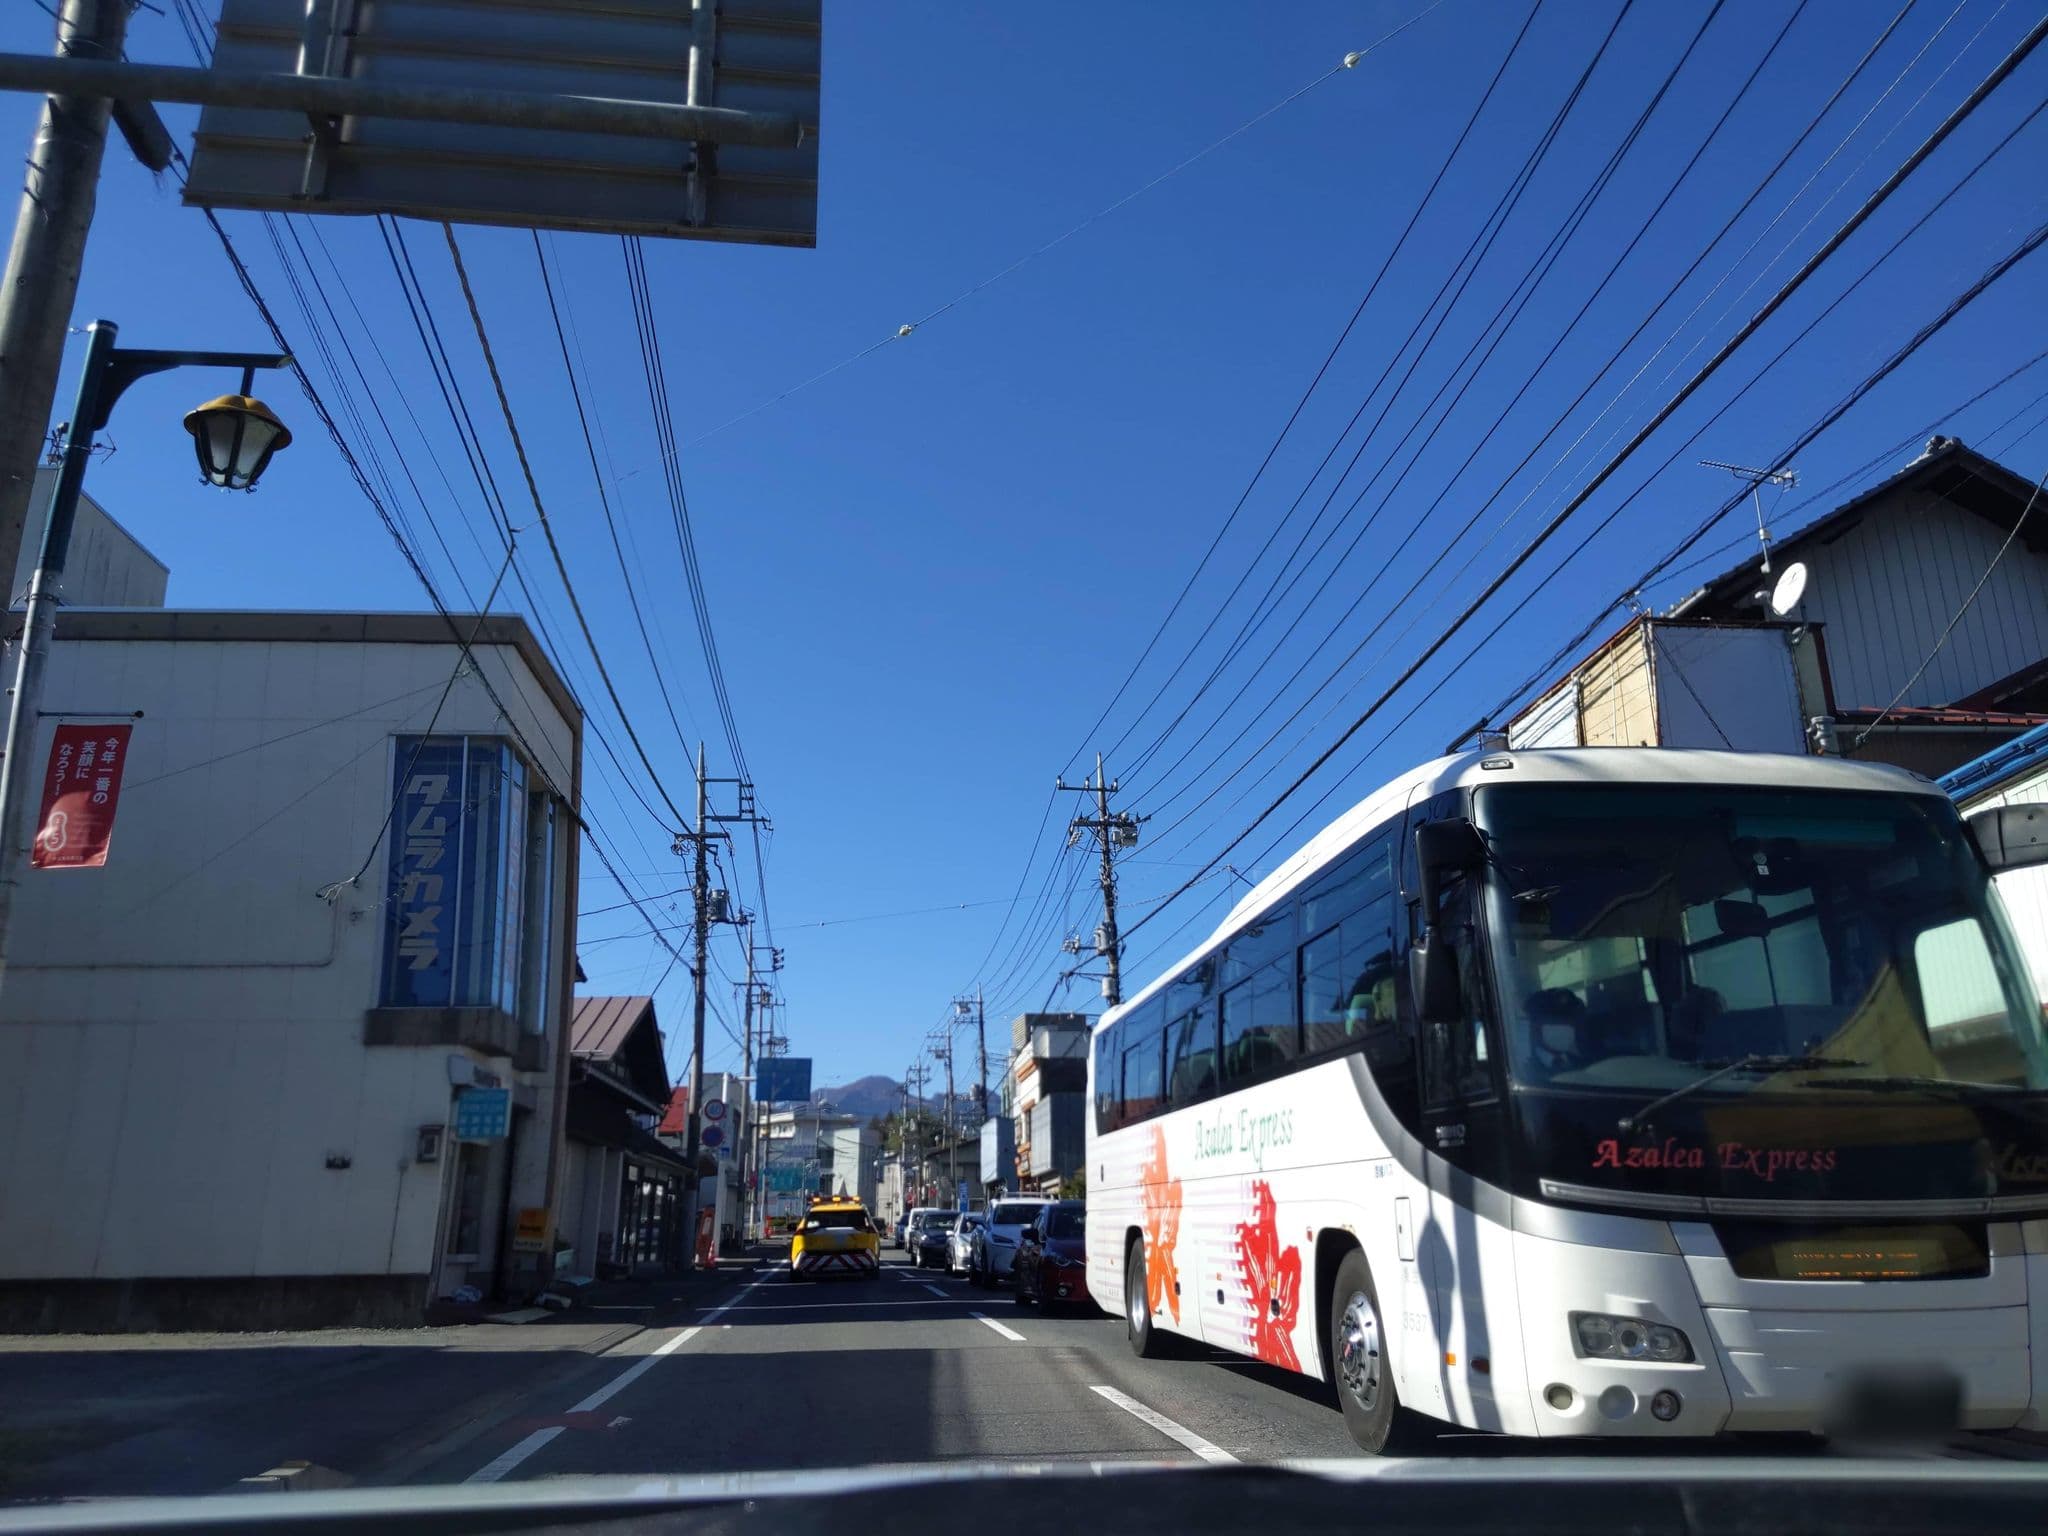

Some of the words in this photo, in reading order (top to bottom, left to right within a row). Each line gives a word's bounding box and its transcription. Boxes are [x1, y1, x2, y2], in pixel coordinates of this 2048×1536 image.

[75, 741, 97, 779] 笑顔に
[93, 737, 119, 804] 今年一番の
[399, 774, 450, 971] タムラカメラ
[1194, 1106, 1234, 1161] Azalea
[1237, 1107, 1294, 1173] Express
[1592, 1137, 1705, 1169] Azalea
[1717, 1141, 1837, 1182] Express
